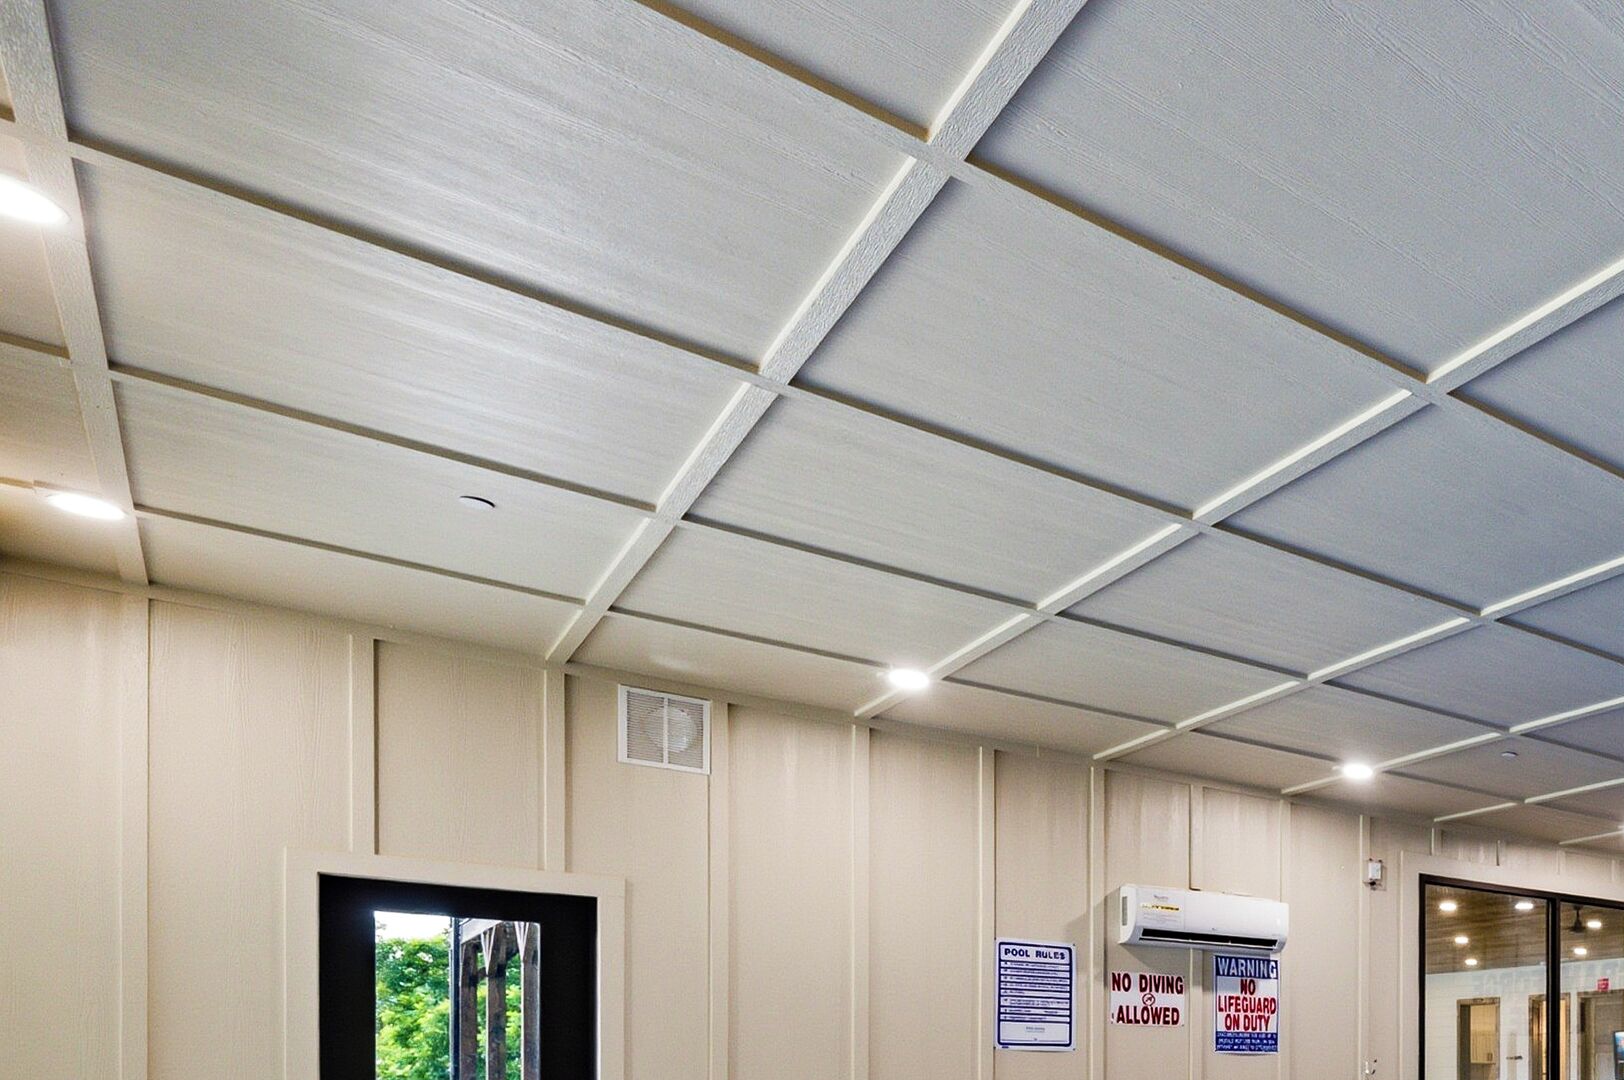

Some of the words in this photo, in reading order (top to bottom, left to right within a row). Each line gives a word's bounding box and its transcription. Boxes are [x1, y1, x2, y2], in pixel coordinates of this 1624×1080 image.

[1004, 948, 1031, 958] POOL
[1035, 950, 1066, 960] RULES
[1217, 957, 1277, 979] WARNING
[1111, 972, 1131, 992] NO
[1139, 974, 1184, 995] DIVING
[1240, 978, 1256, 996] NO
[1218, 995, 1277, 1015] LIFEGUARD
[1116, 1005, 1180, 1026] ALLOWED
[1224, 1013, 1240, 1031] ON
[1243, 1014, 1270, 1032] DUTY
